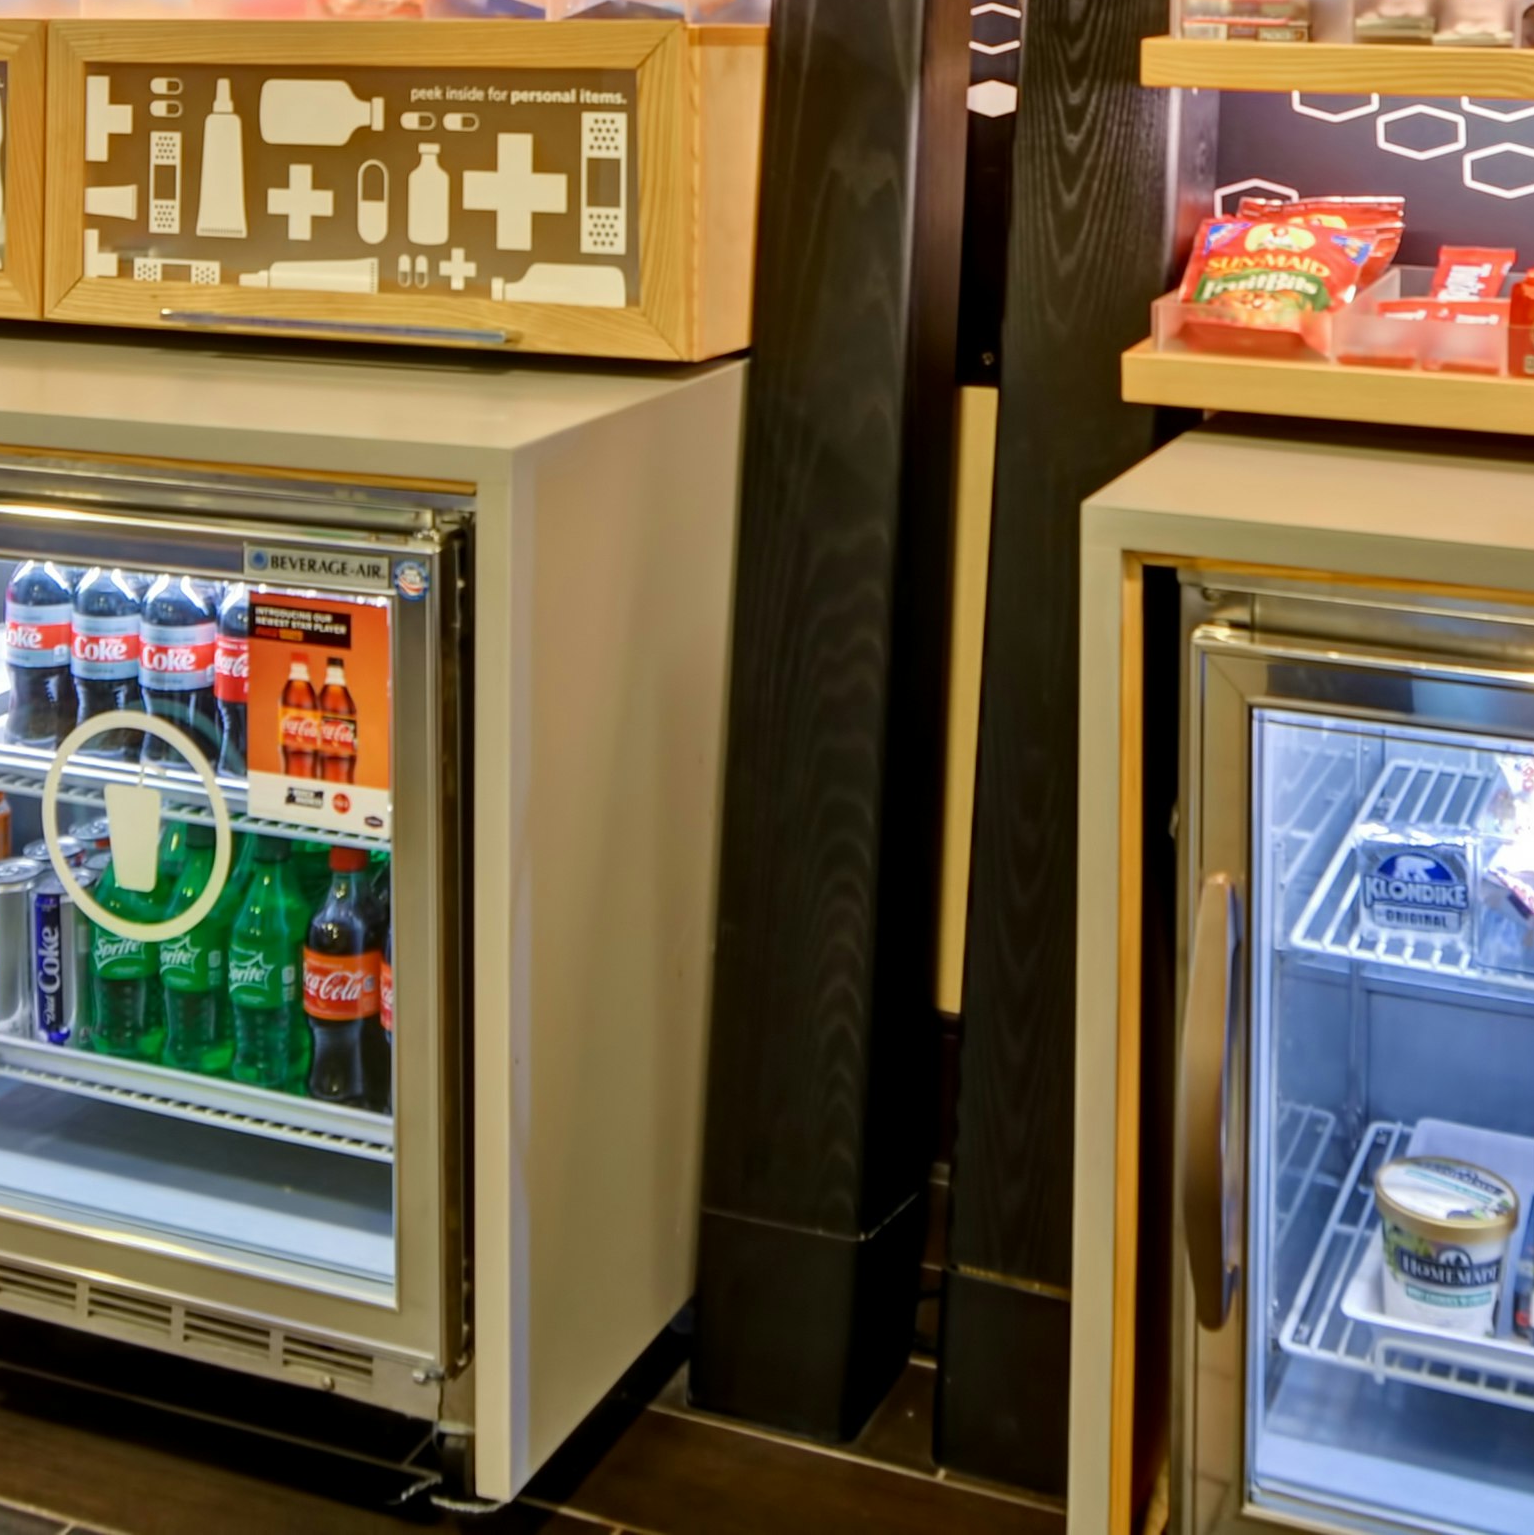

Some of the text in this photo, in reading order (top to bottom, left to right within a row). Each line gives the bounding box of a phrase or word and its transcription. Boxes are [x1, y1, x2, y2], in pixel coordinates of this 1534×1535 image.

[410, 86, 628, 105] peek inside for personal items.
[270, 555, 383, 580] BEVERAGE-AIR
[255, 606, 333, 623] INTRODUCING OUR
[255, 616, 290, 628] NEWEST
[291, 619, 313, 631] STAR
[314, 623, 347, 635] PLAYER
[74, 634, 127, 661] Coke
[142, 645, 196, 671] Coke
[1365, 875, 1467, 908] KLONDIKE
[1385, 909, 1447, 929] ORIGINAL
[95, 939, 141, 958] Sprite
[38, 926, 61, 994] Coke
